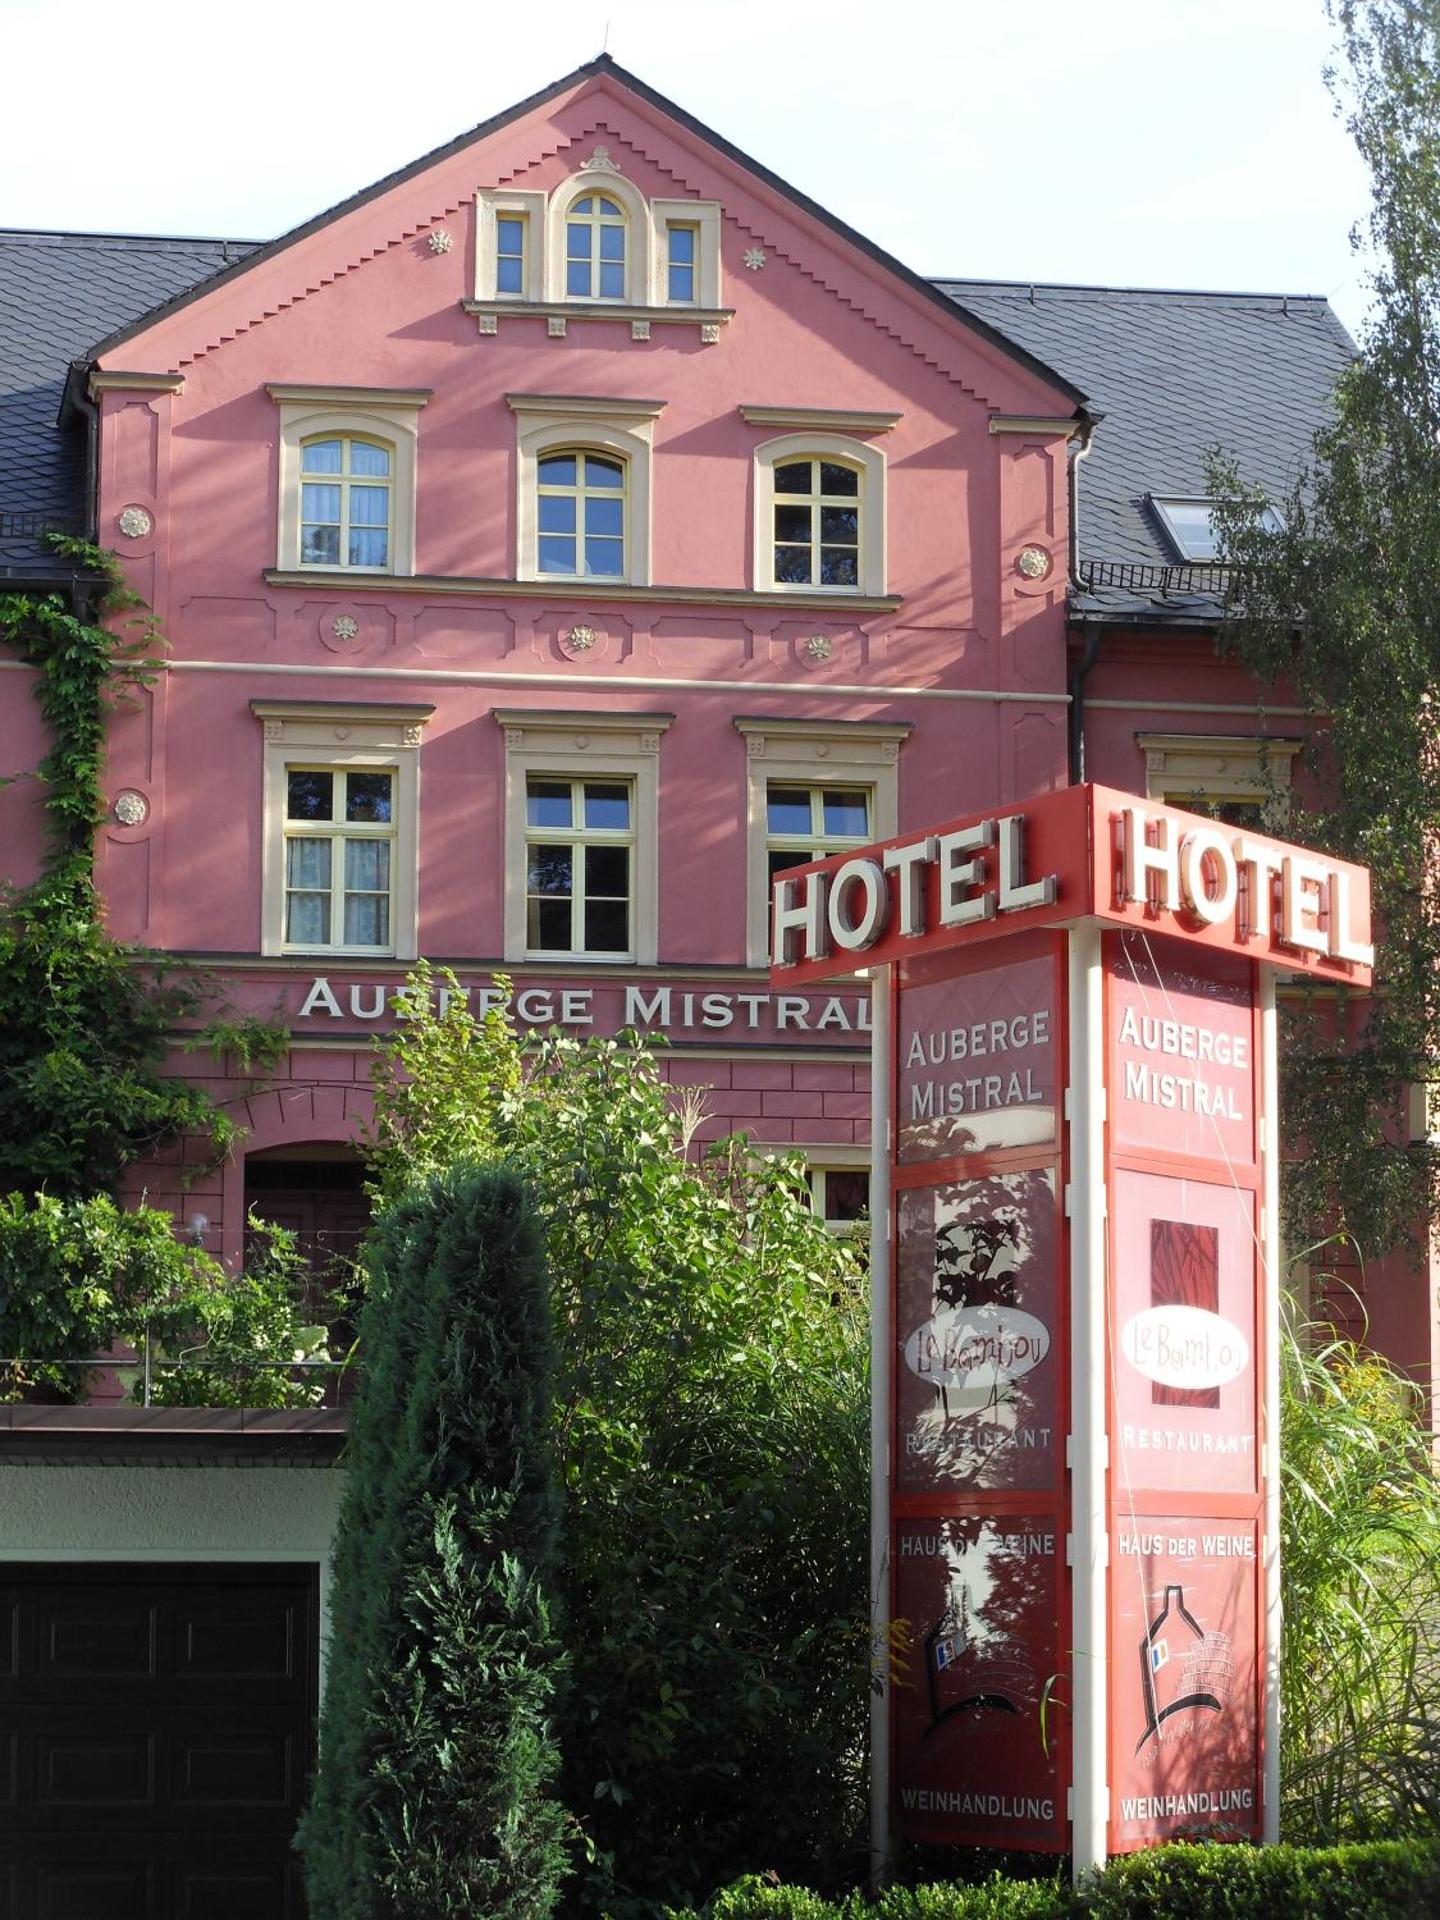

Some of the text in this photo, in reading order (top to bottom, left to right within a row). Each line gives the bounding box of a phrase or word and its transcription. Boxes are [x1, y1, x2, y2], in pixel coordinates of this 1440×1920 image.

[773, 812, 1056, 969] HOTEL
[1121, 806, 1375, 970] HOTEL
[624, 986, 873, 1032] MISTRAL
[906, 1010, 1051, 1070] AUBERGE
[1119, 1006, 1249, 1070] AUBERGE
[911, 1069, 1044, 1121] MISTRAL
[1125, 1061, 1243, 1121] MISTRAL
[1123, 1425, 1252, 1454] RESTAURANT
[1118, 1535, 1254, 1557] HAUS DER WEINE
[902, 1788, 1055, 1821] WEINHANDLUNG
[1121, 1788, 1253, 1820] WEINHANDLUNG
